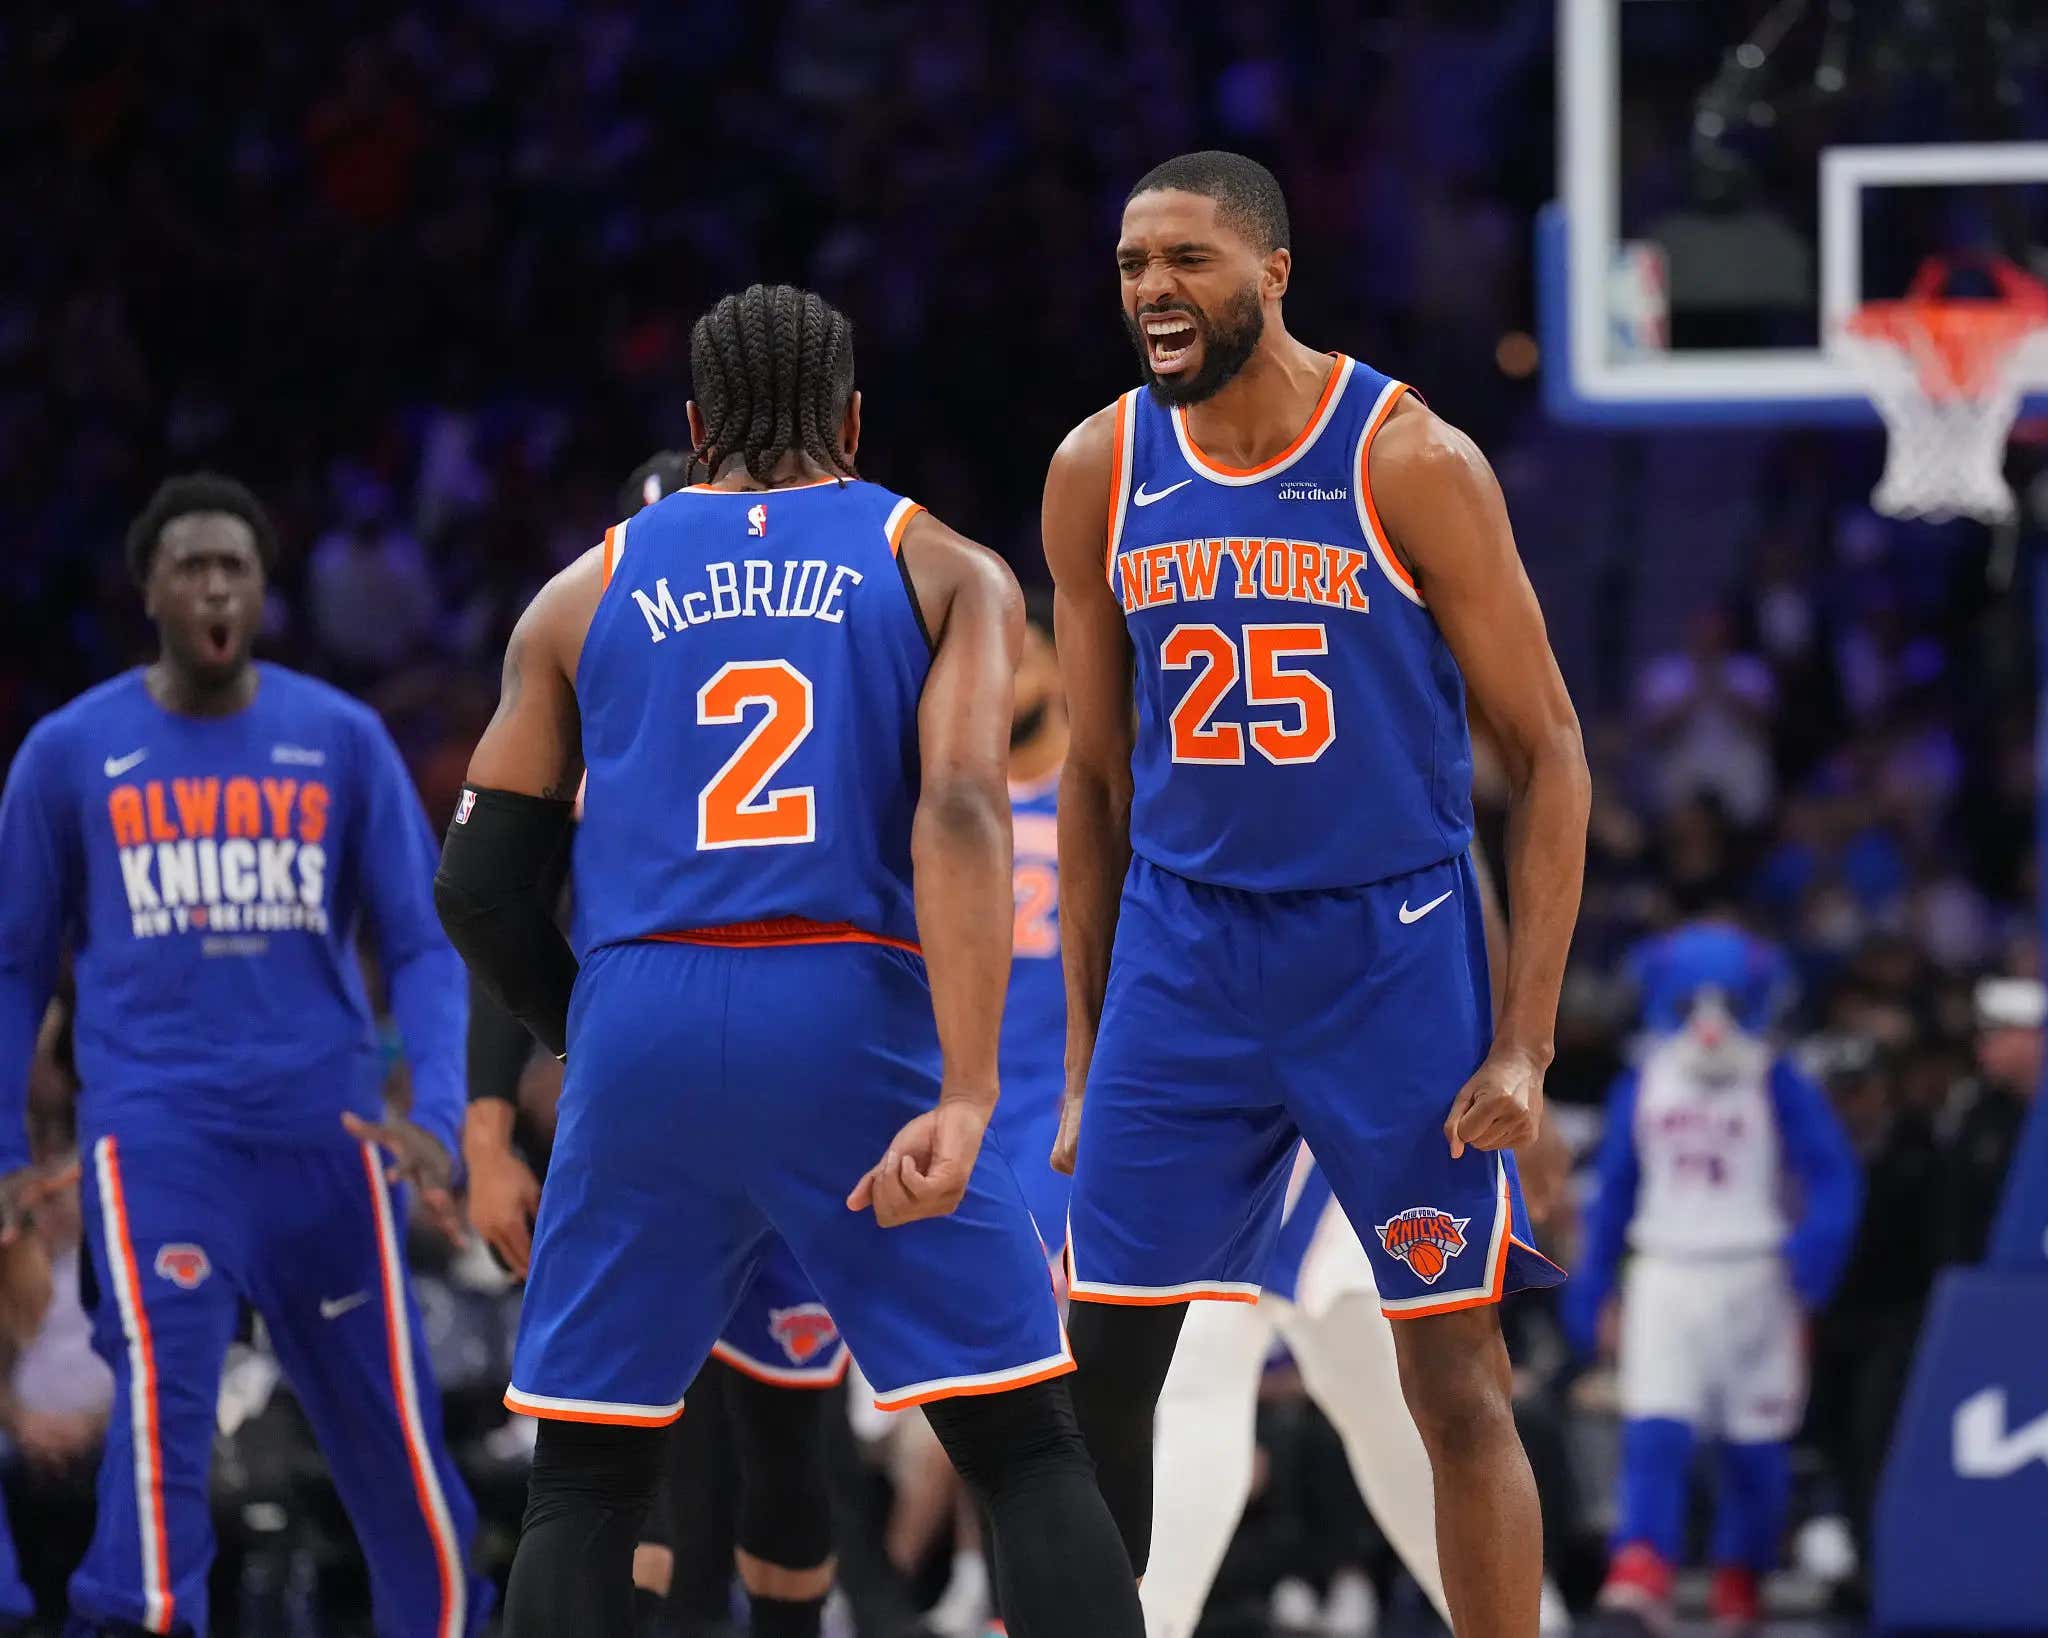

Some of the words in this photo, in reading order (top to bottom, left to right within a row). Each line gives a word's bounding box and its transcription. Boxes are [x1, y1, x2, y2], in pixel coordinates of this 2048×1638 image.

[1278, 488, 1305, 500] abu
[1307, 487, 1347, 500] dhabi
[631, 560, 864, 643] McBRIDE
[1118, 537, 1224, 615] NEW
[1225, 536, 1370, 614] YORK
[1160, 623, 1337, 766] 25
[696, 659, 816, 851] 2
[108, 775, 331, 850] ALWAYS
[119, 837, 327, 914] KNICKS
[1385, 1214, 1464, 1250] KNICKS
